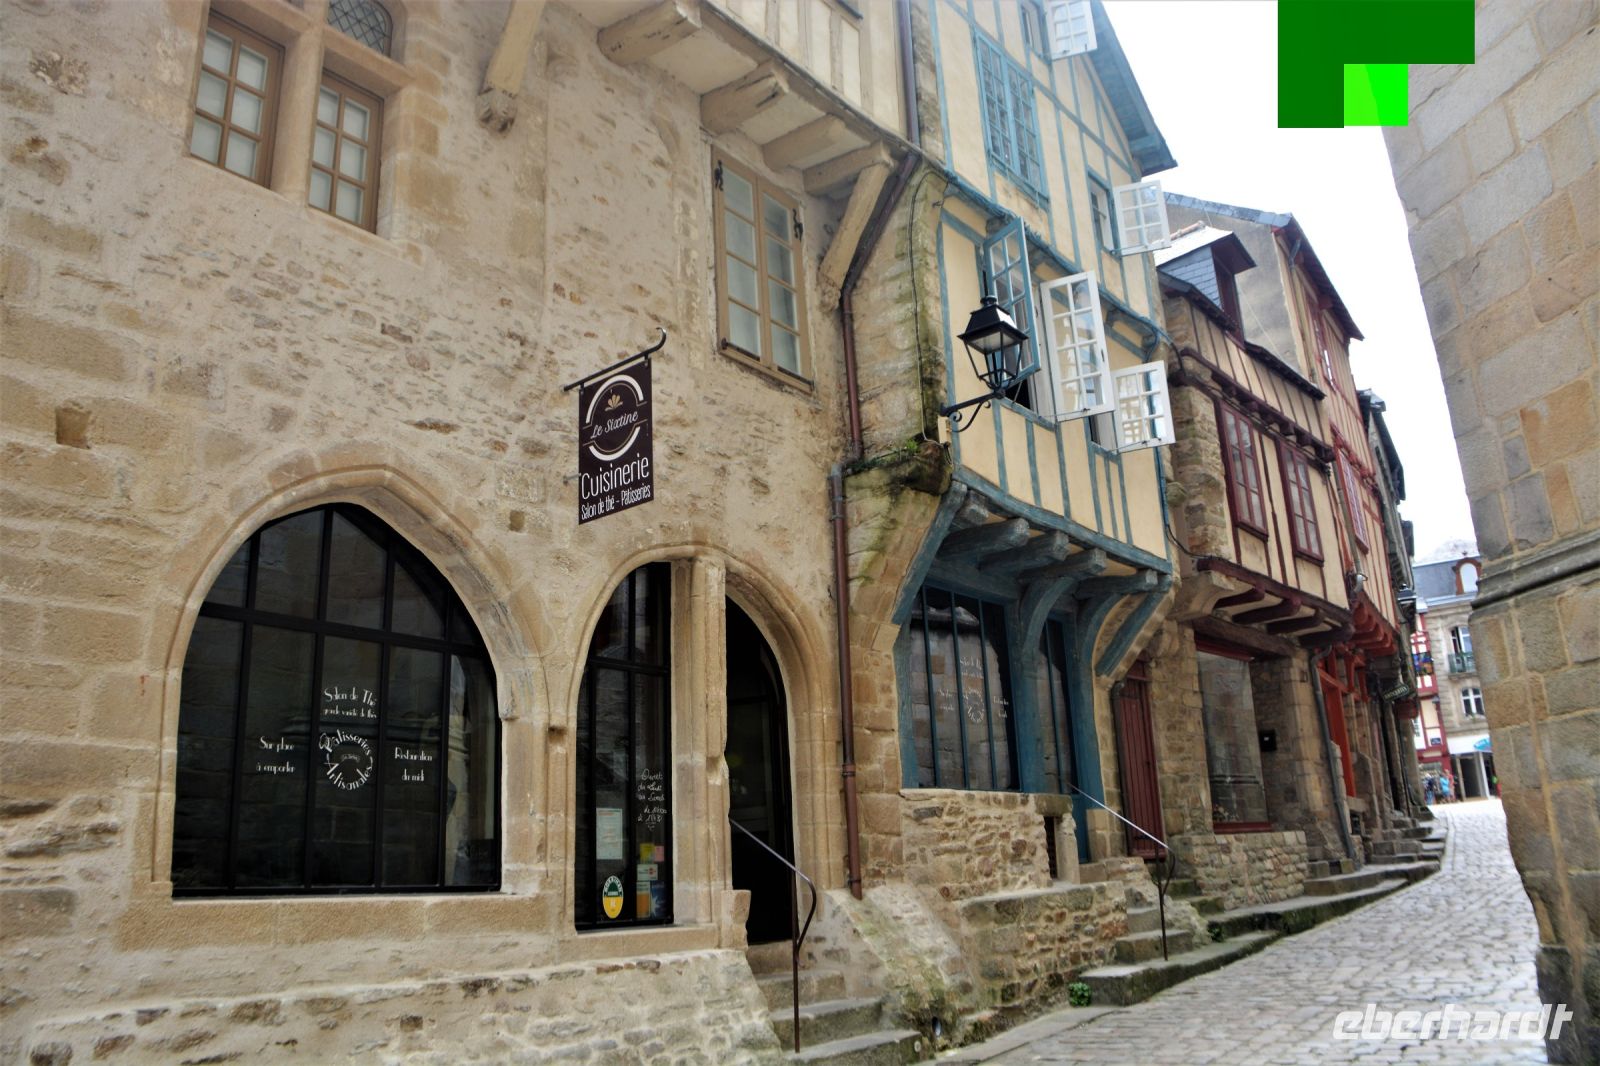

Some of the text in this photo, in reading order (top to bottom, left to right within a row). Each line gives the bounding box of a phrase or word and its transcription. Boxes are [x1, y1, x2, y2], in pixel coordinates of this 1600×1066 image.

[590, 424, 603, 440] Le
[604, 411, 638, 431] Sixtine
[581, 453, 650, 500] Cuisinerie
[581, 502, 597, 520] Salon
[597, 498, 605, 515] de
[605, 495, 615, 512] thé
[621, 483, 651, 506] Pâtisseries
[259, 735, 274, 750] Sur
